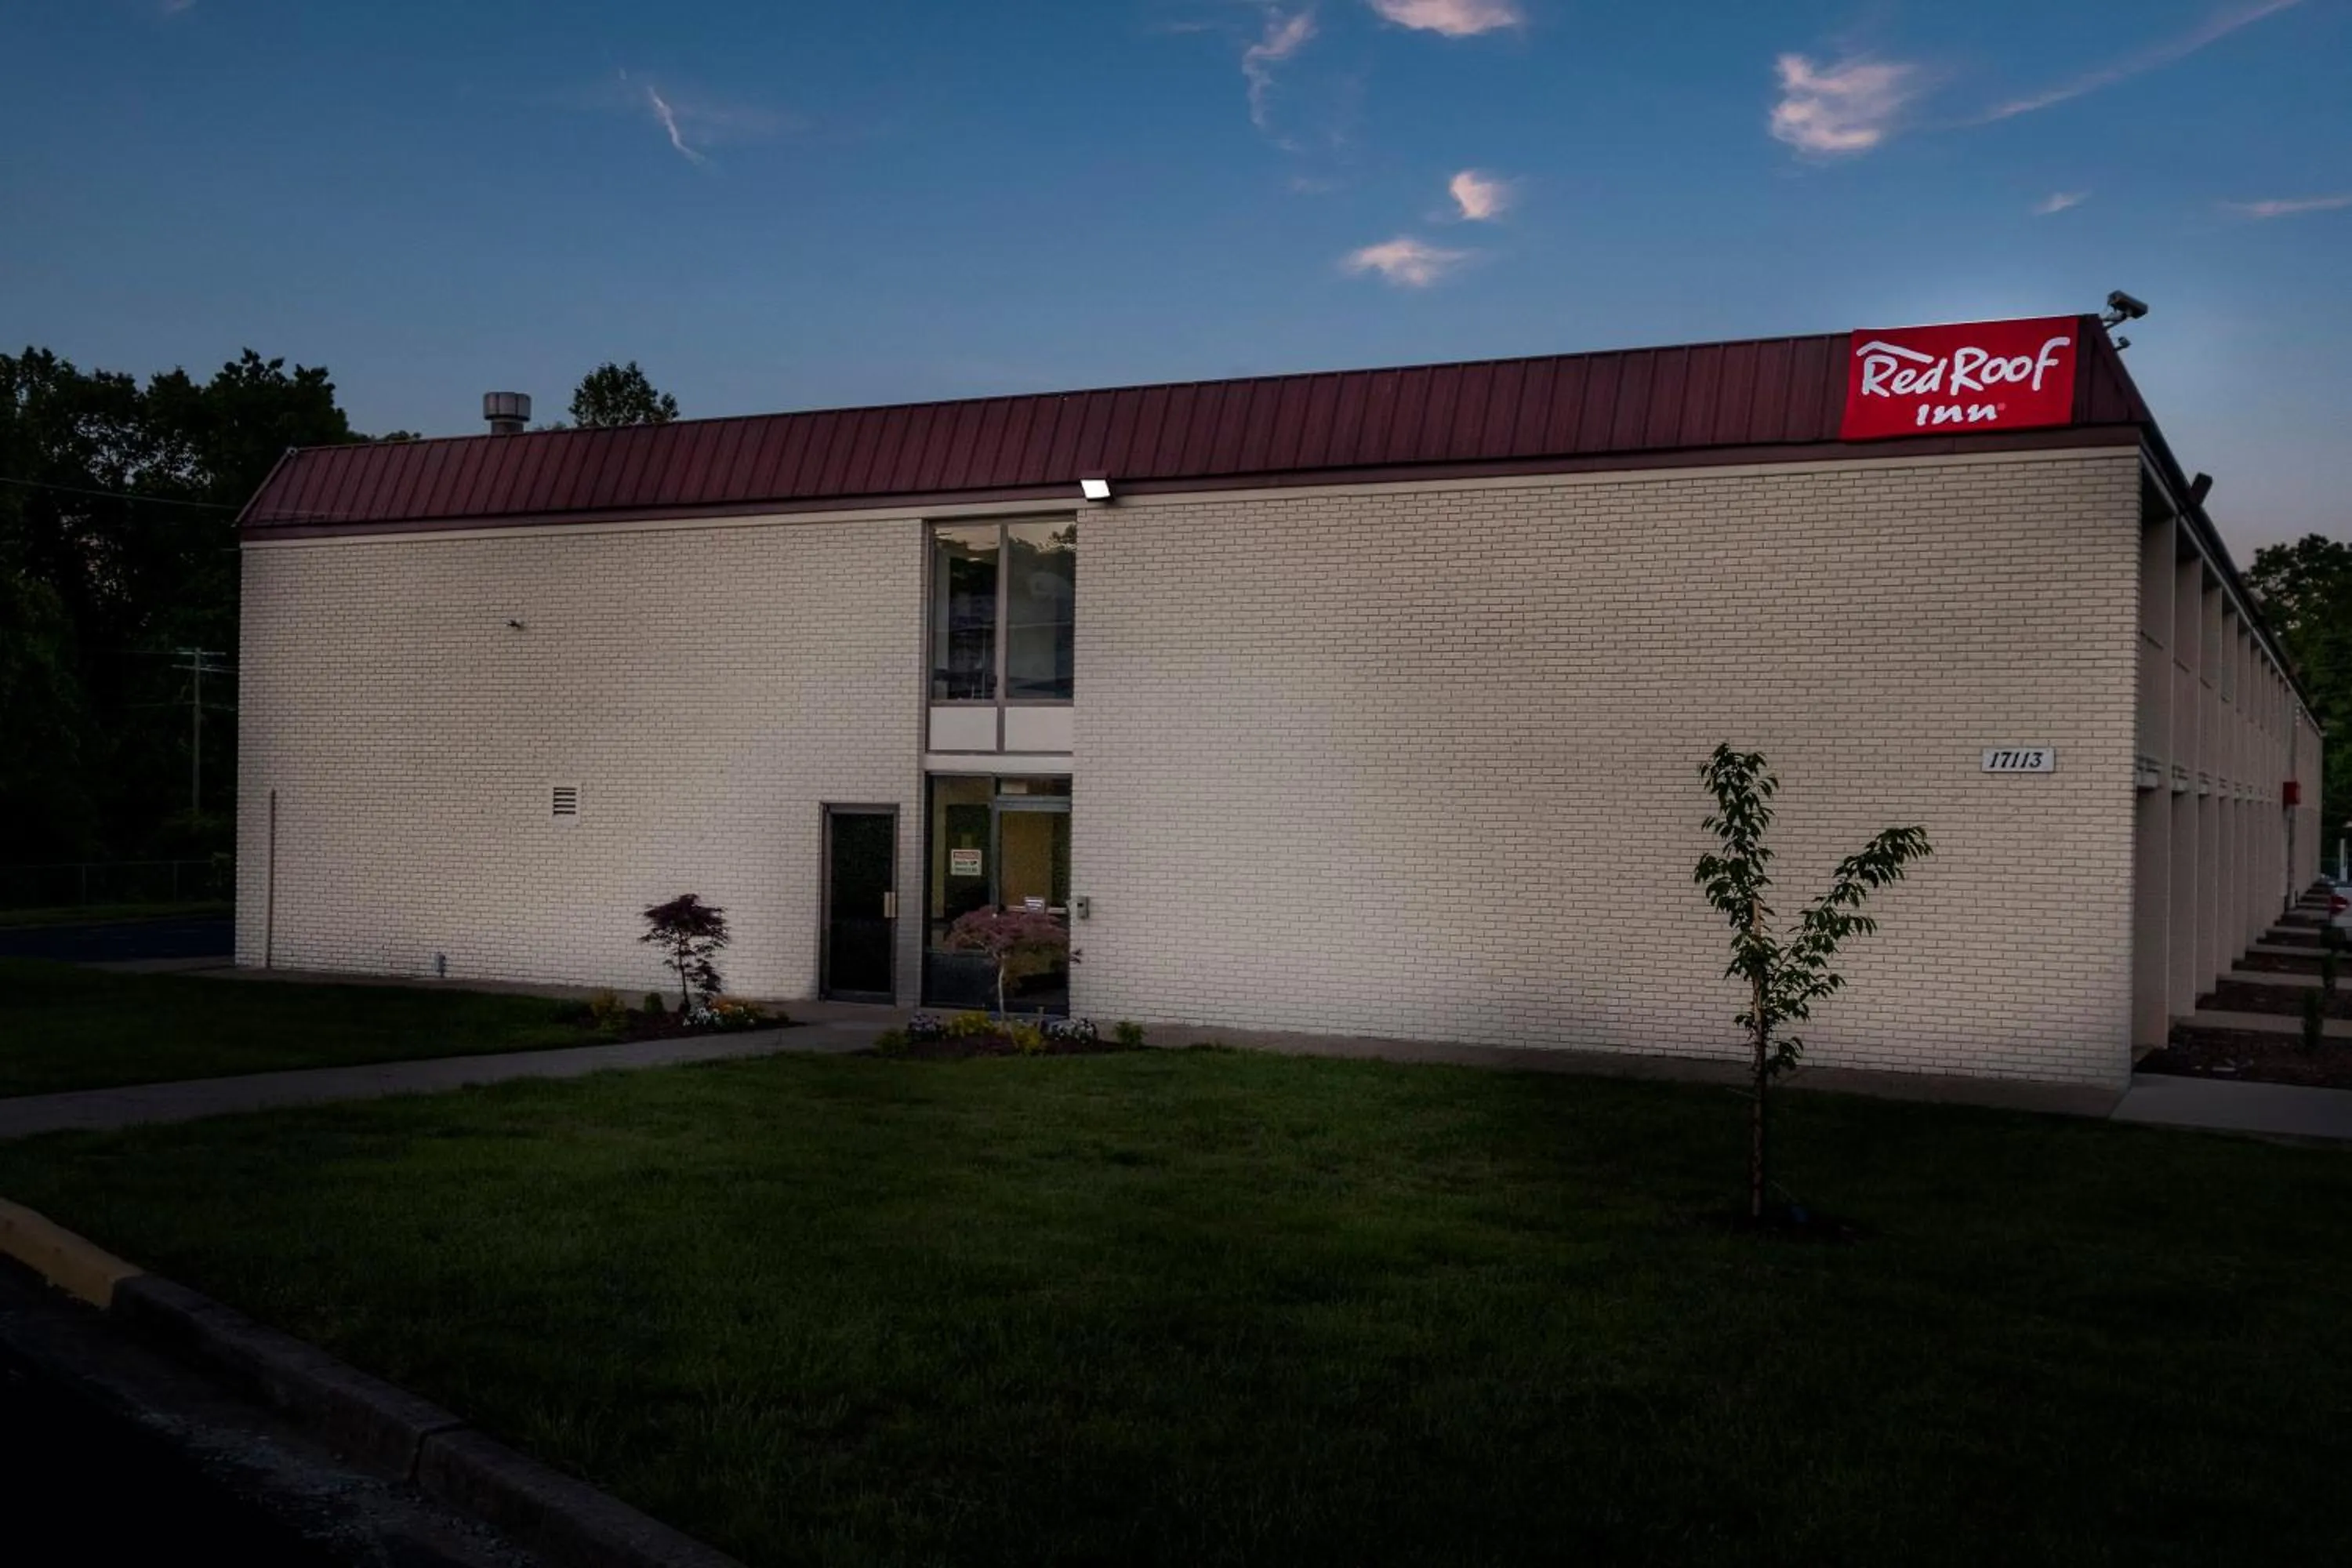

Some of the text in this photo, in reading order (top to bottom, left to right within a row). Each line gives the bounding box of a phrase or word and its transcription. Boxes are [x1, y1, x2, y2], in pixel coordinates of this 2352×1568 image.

[1861, 336, 2071, 397] Red Roof
[1989, 751, 2043, 768] 17113
